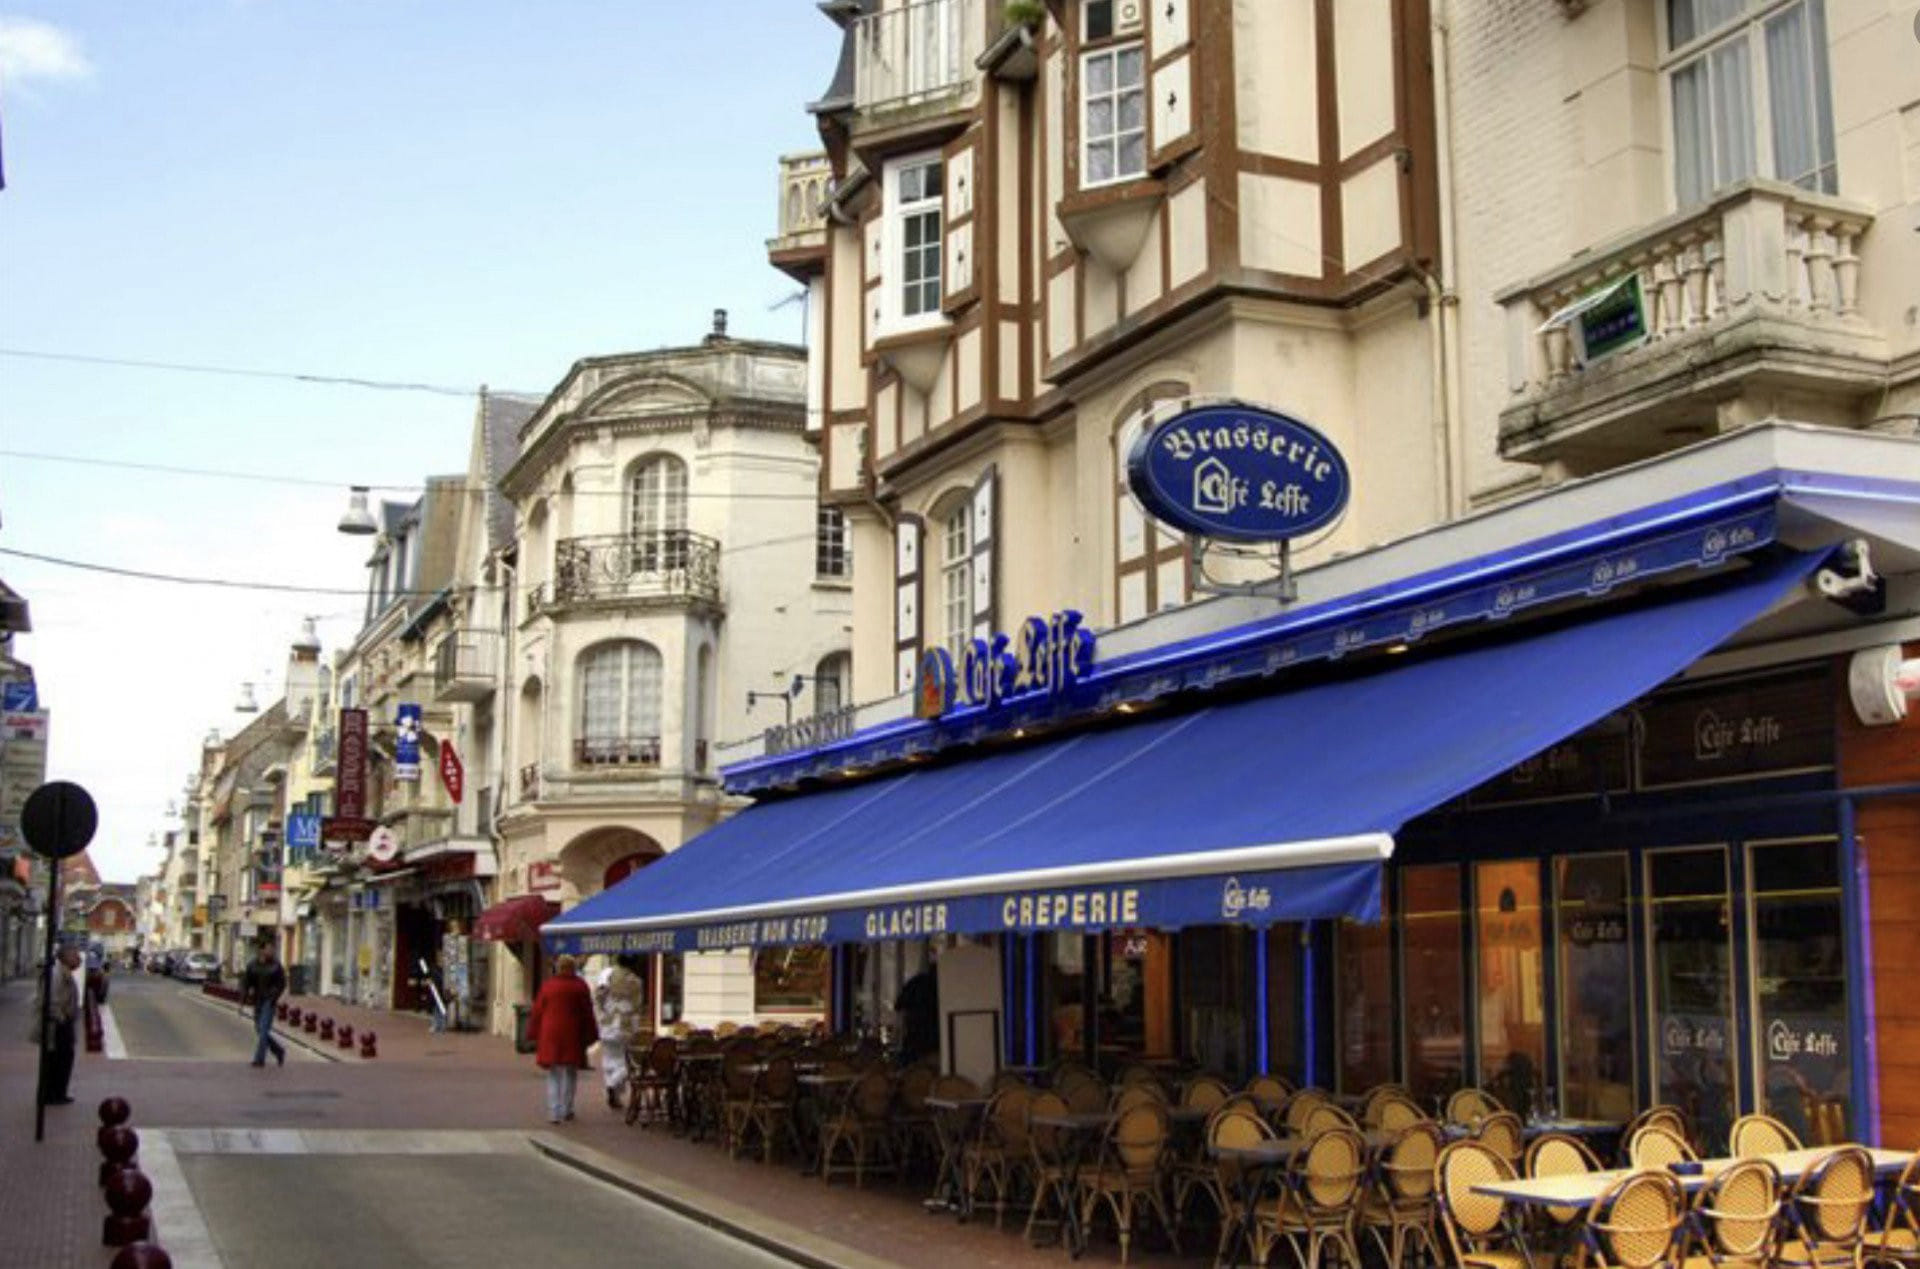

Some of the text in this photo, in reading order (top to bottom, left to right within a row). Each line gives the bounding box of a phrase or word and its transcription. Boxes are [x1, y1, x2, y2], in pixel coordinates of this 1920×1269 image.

[1163, 424, 1331, 482] Brasserie
[1202, 472, 1311, 517] Café Leffe
[955, 609, 1097, 712] Café Leffe
[1700, 716, 1780, 748] Café Leffe
[866, 904, 948, 937] GLACIER
[1003, 889, 1140, 928] CREPERIE
[697, 921, 757, 947] BRASSERIE
[792, 915, 828, 941] STOP
[1774, 1030, 1839, 1055] Café Leffe
